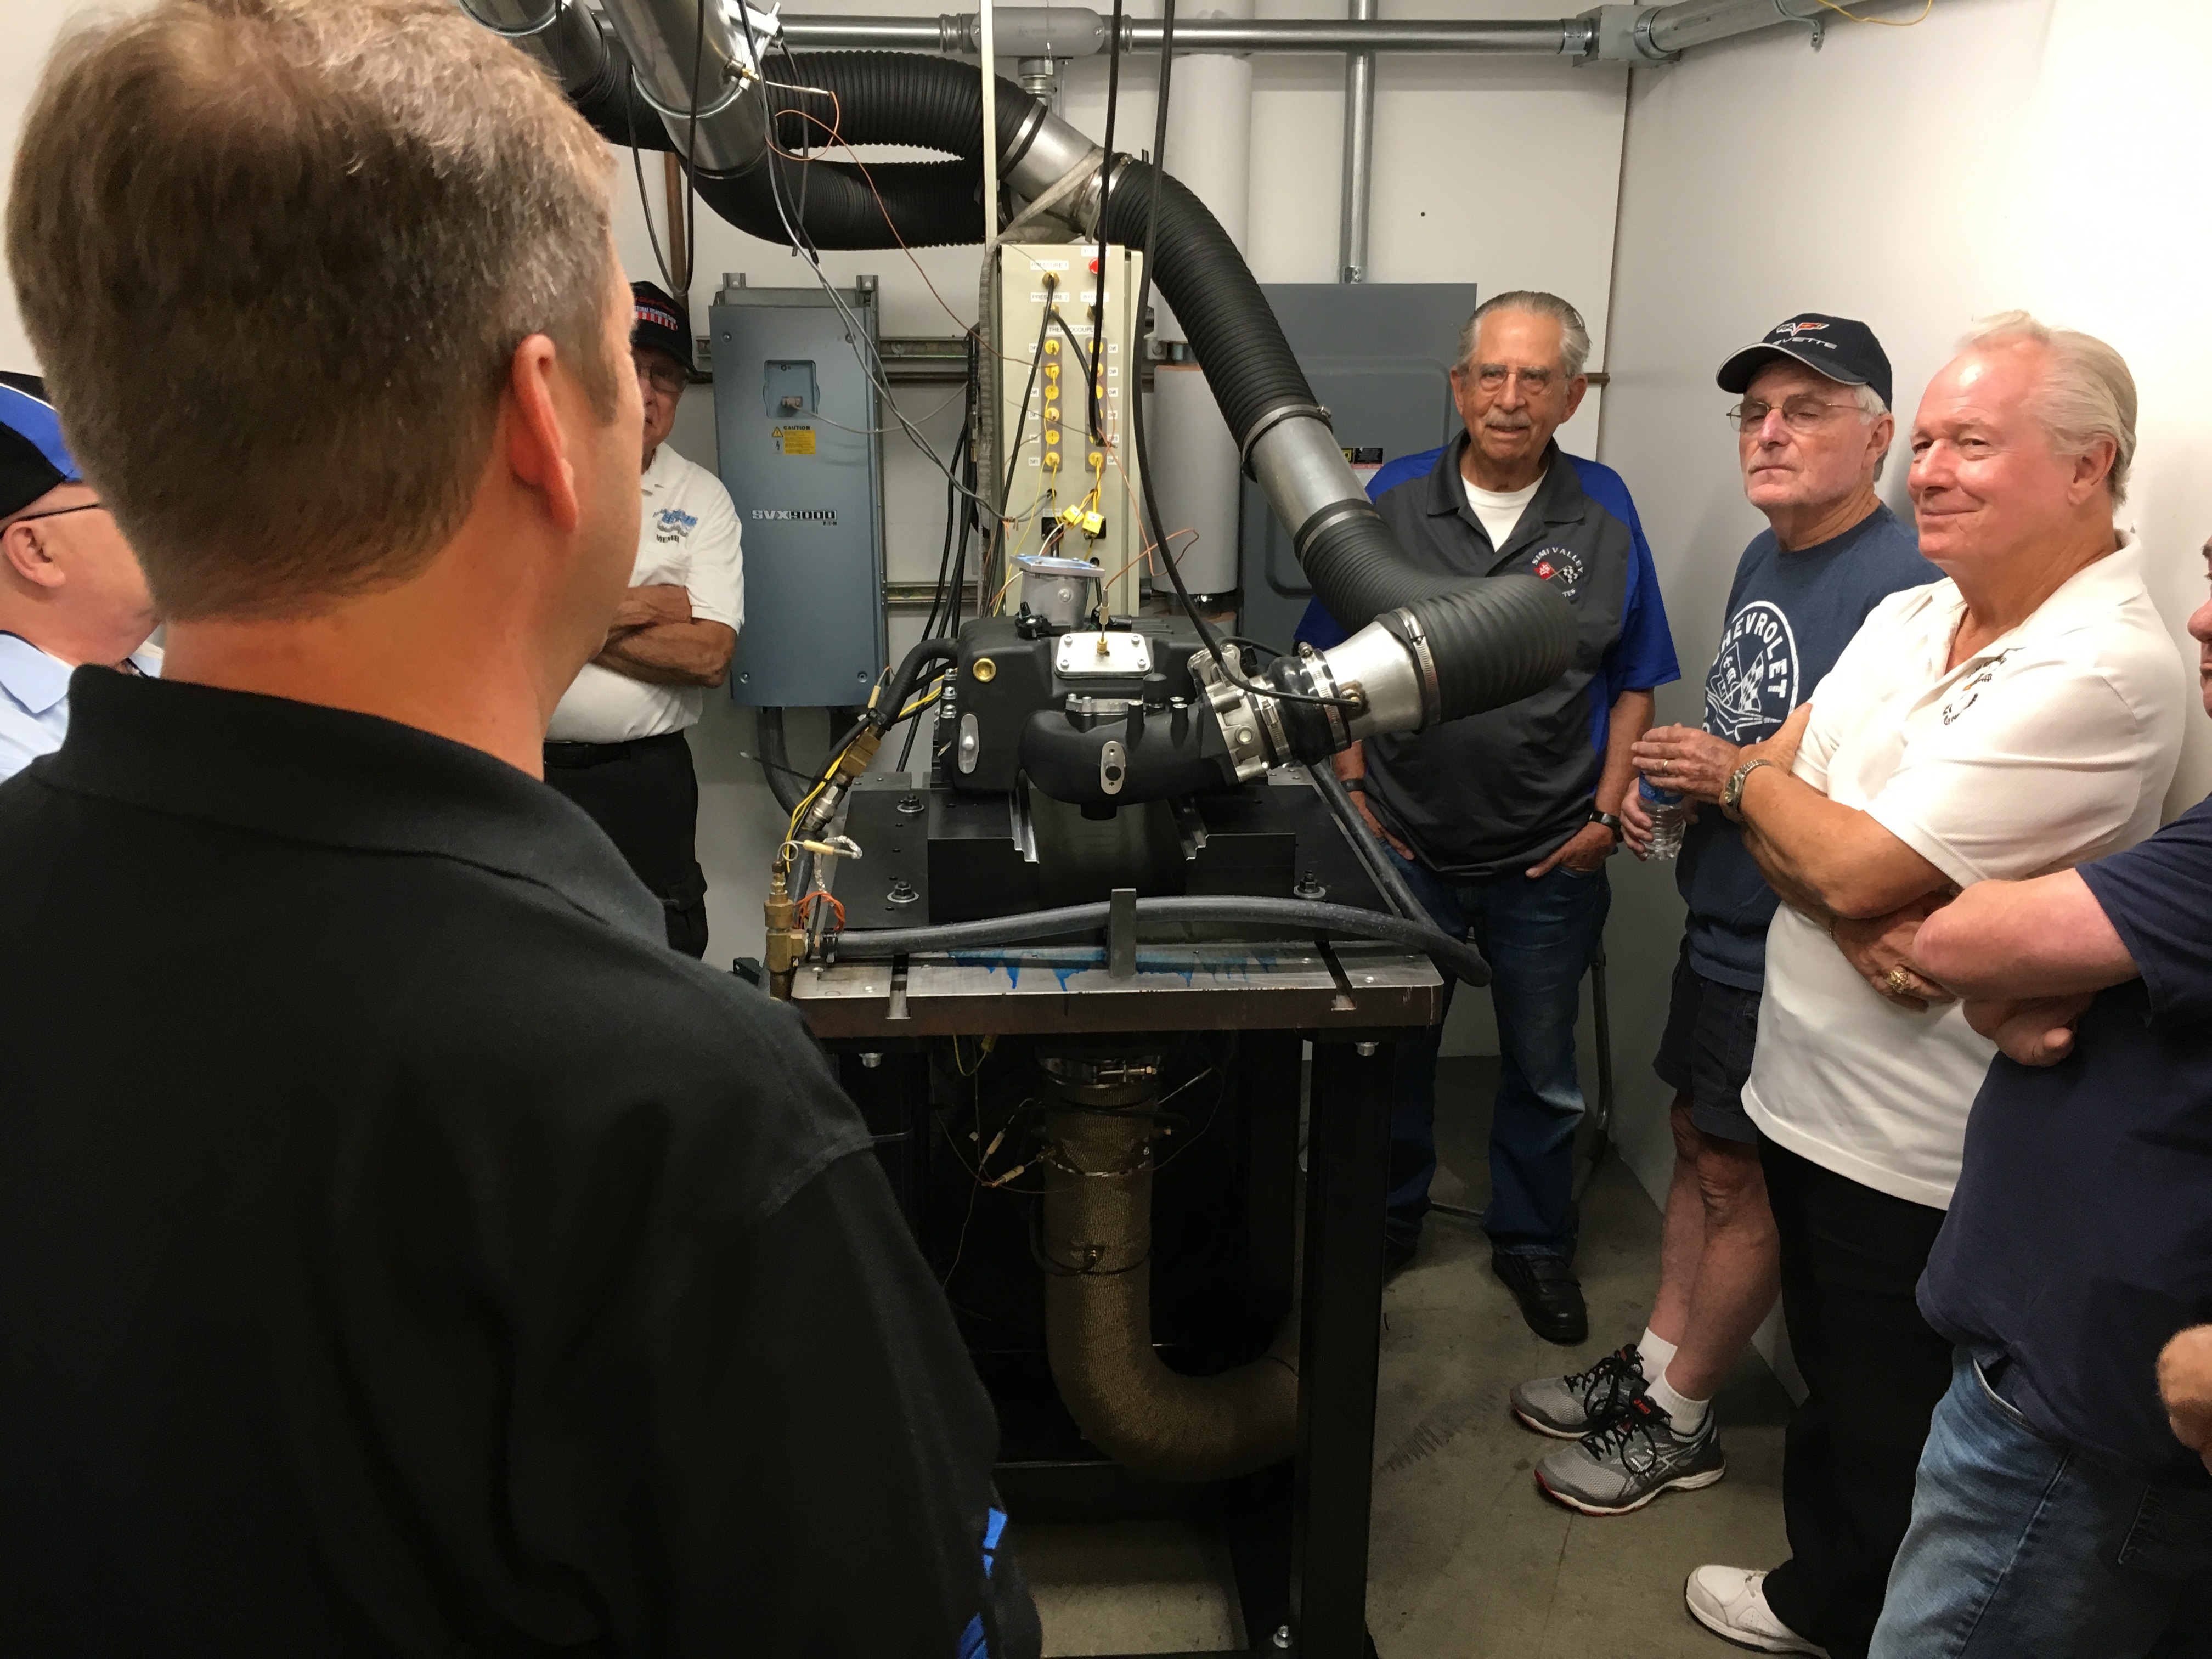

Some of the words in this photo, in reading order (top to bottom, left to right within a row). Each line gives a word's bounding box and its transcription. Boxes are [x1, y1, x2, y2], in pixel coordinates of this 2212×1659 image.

[752, 510, 837, 520] SVX9000
[1532, 548, 1550, 566] SIMI
[1552, 547, 1584, 573] VALLEY
[1562, 588, 1576, 597] TES
